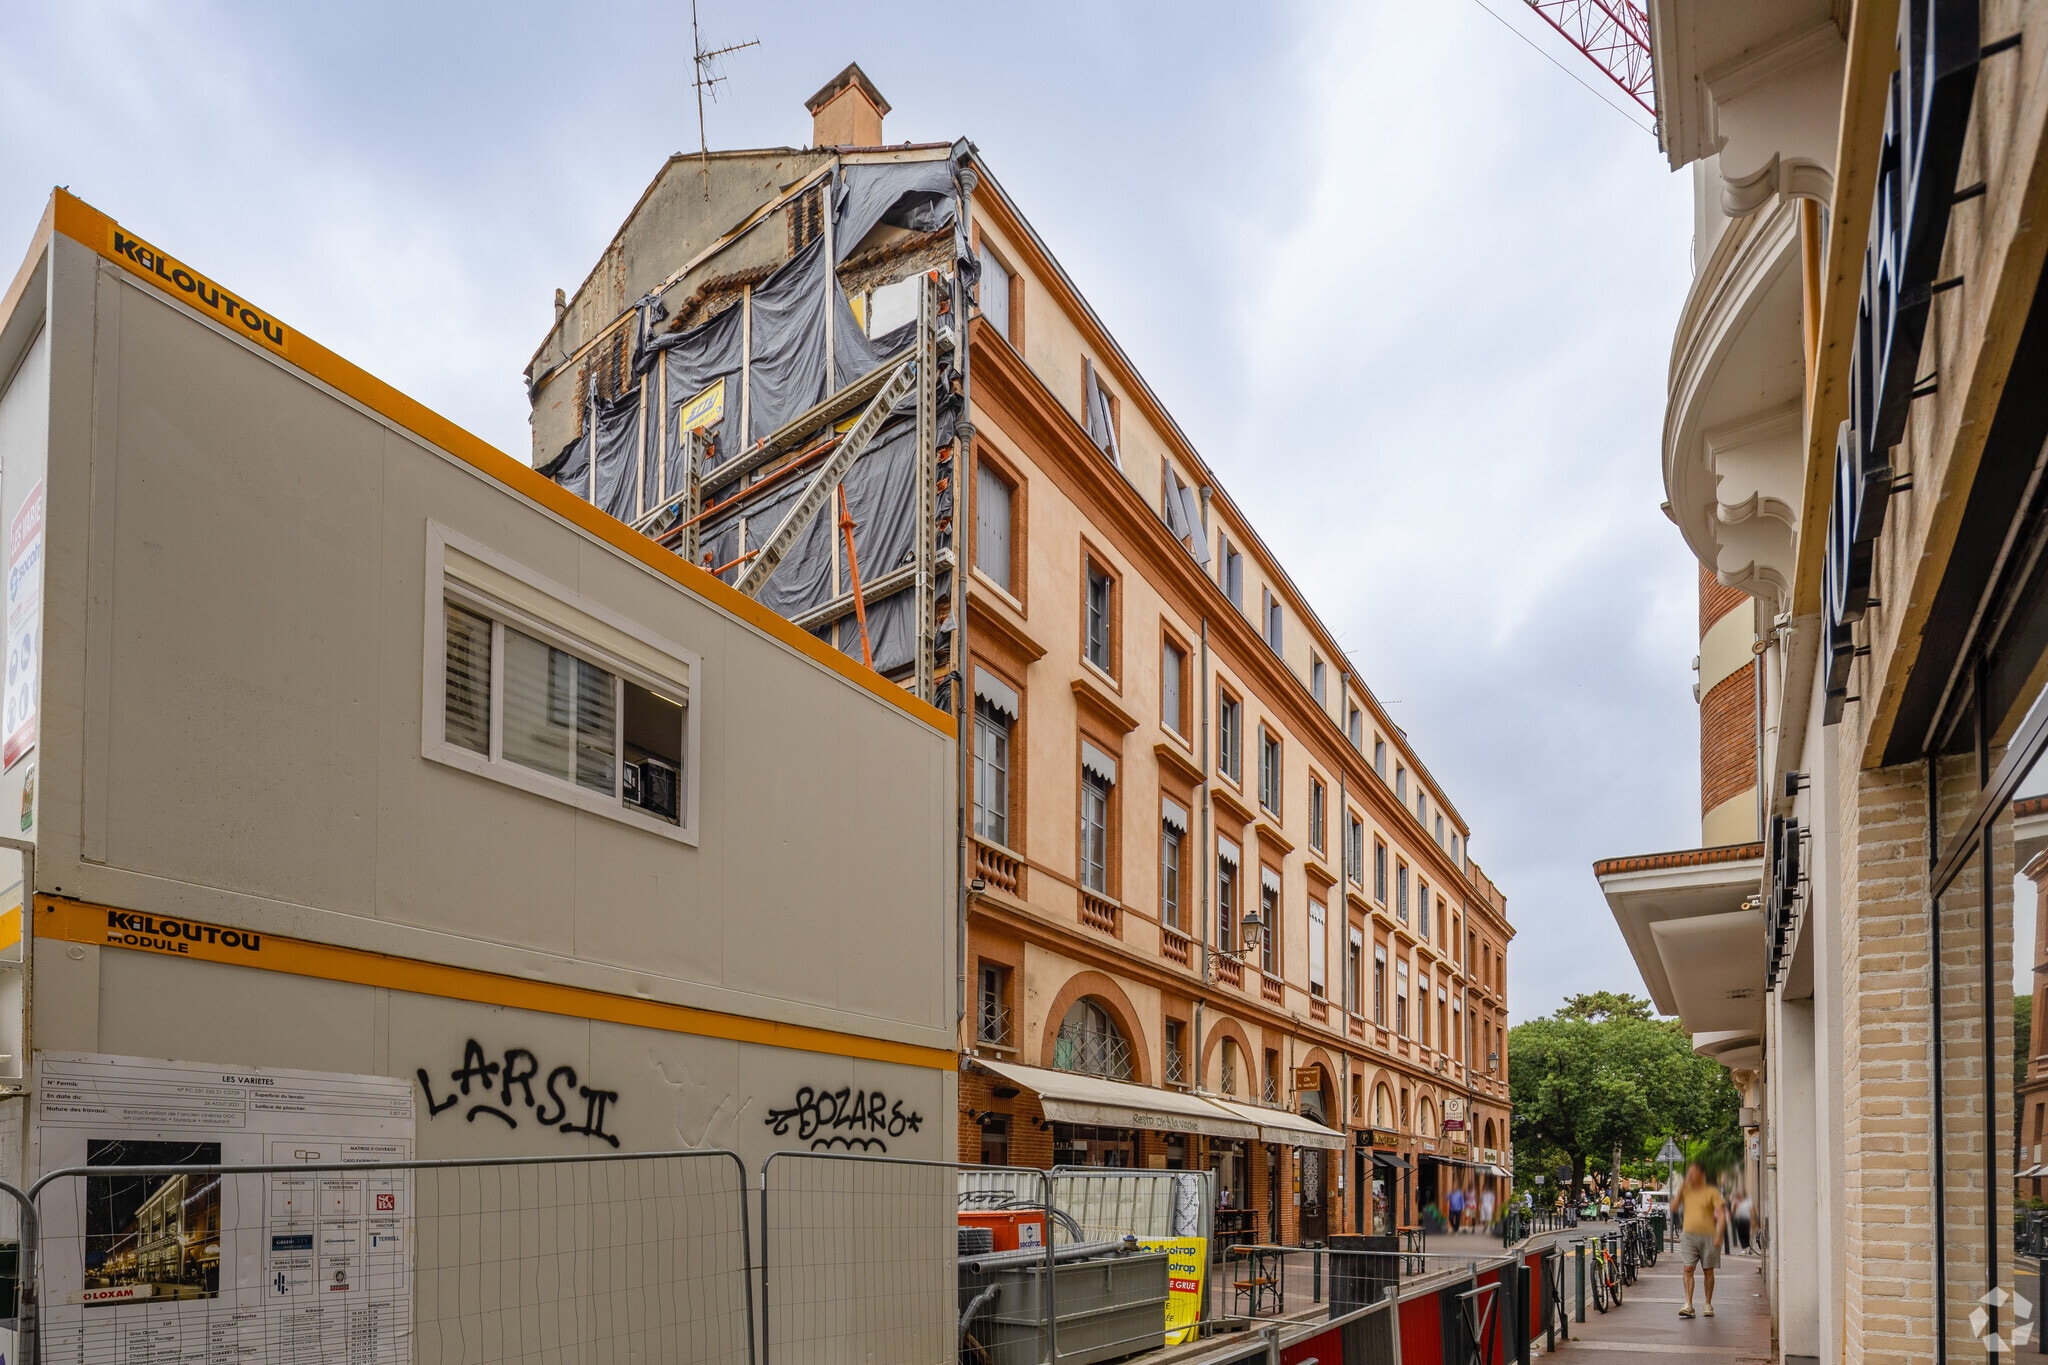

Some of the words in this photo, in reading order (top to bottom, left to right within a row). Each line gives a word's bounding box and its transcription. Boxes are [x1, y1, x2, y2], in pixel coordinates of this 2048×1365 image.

[107, 933, 189, 953] MODULE
[222, 1075, 236, 1083] LES
[238, 1076, 274, 1086] VARIETES
[123, 1109, 167, 1117] Restructuration
[1154, 1246, 1196, 1256] scotrap
[1169, 1262, 1196, 1274] otrap
[1175, 1281, 1196, 1290] GRUE
[92, 1288, 134, 1300] LOXAM
